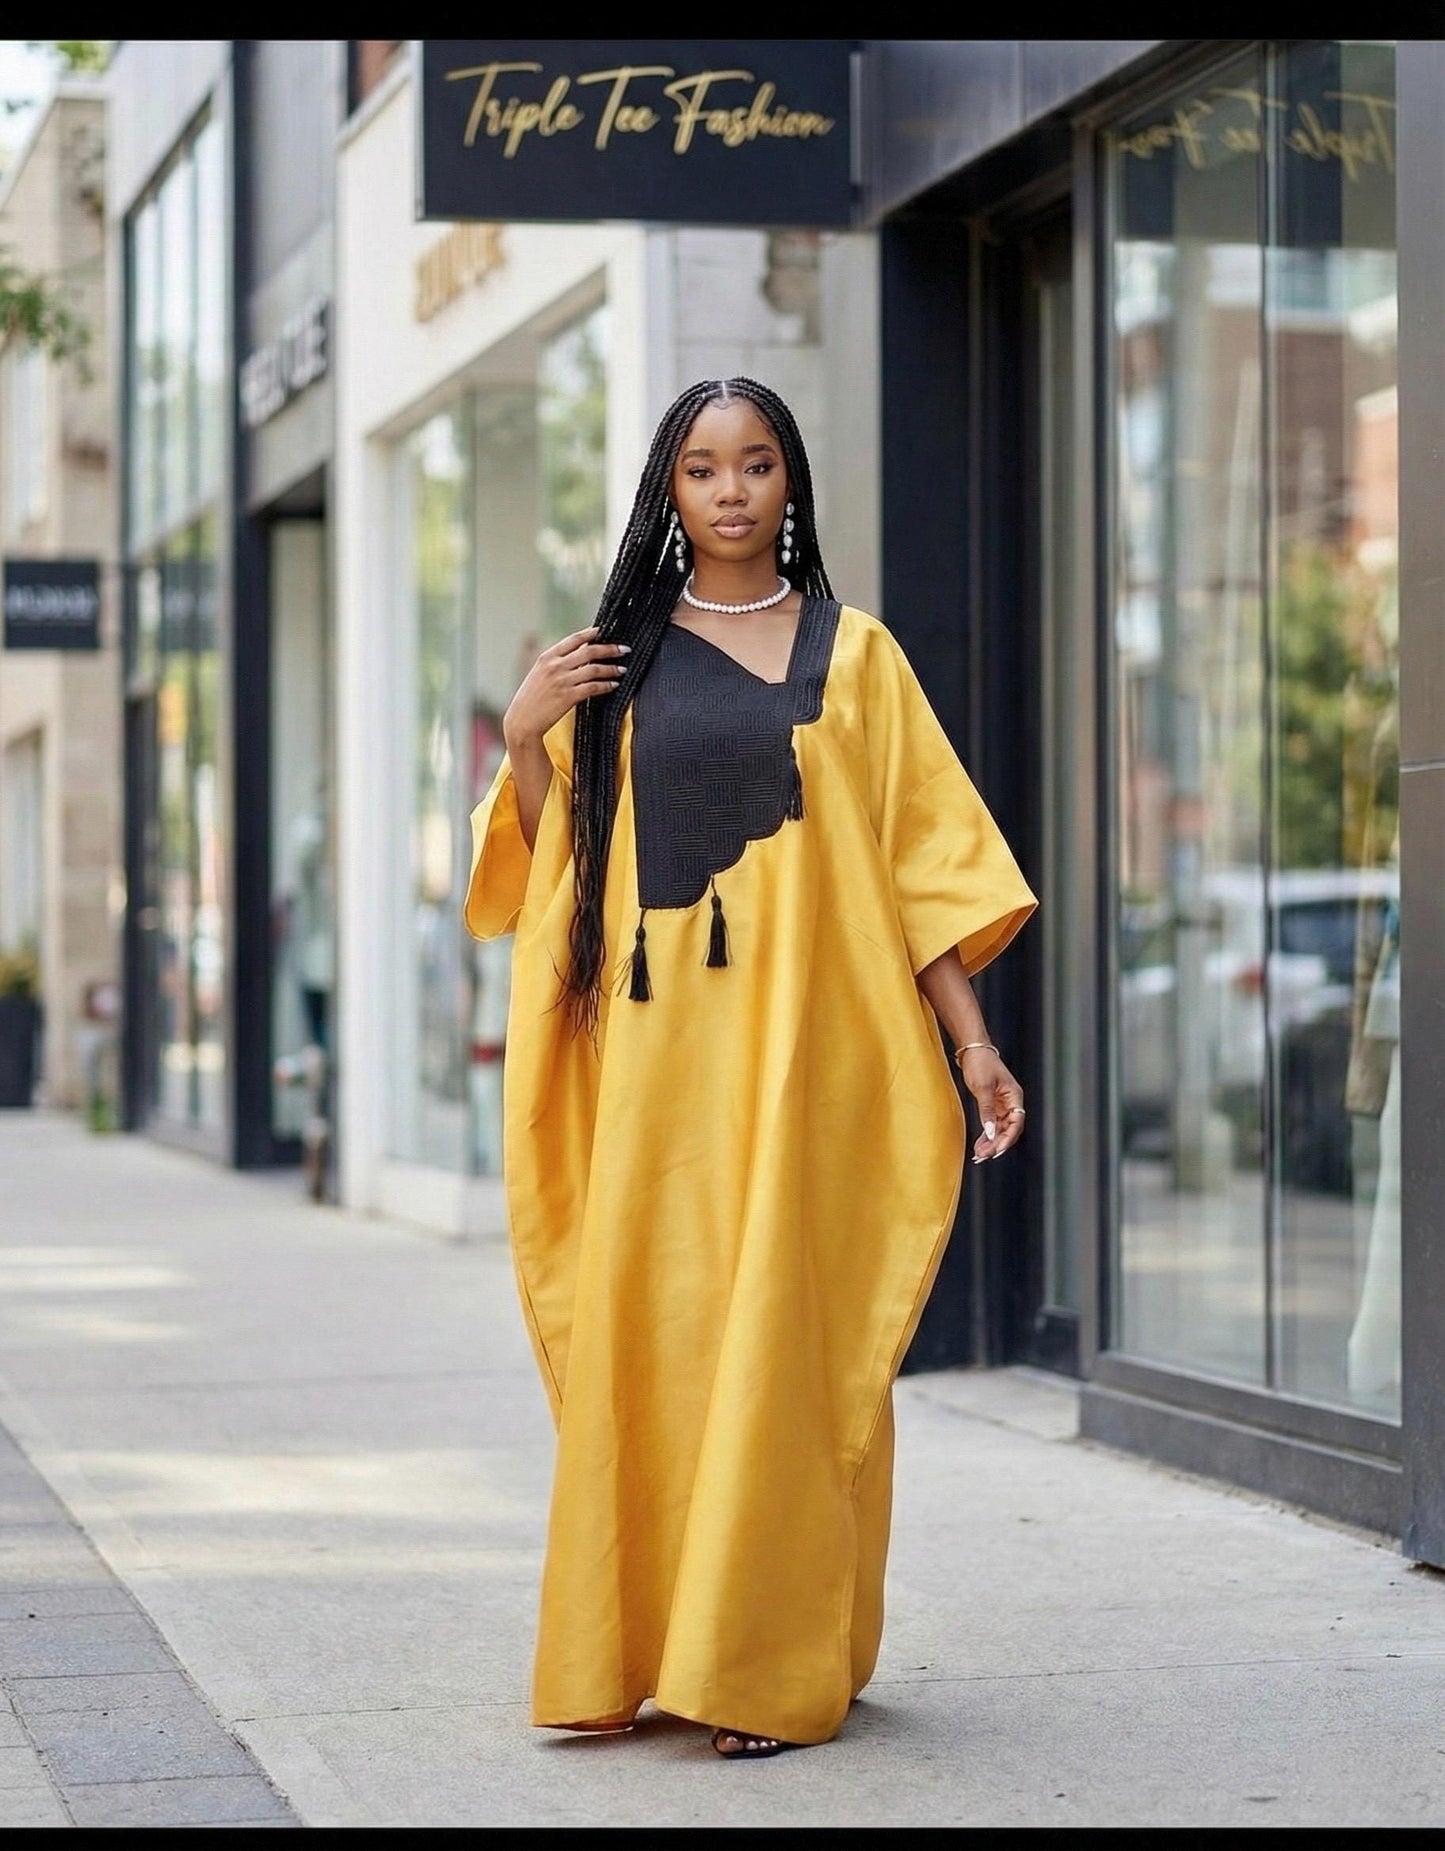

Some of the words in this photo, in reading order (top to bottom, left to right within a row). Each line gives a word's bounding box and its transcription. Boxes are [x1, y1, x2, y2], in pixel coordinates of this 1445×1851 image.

[445, 62, 586, 159] Triple
[576, 65, 676, 151] Tee
[663, 69, 836, 155] Fashion
